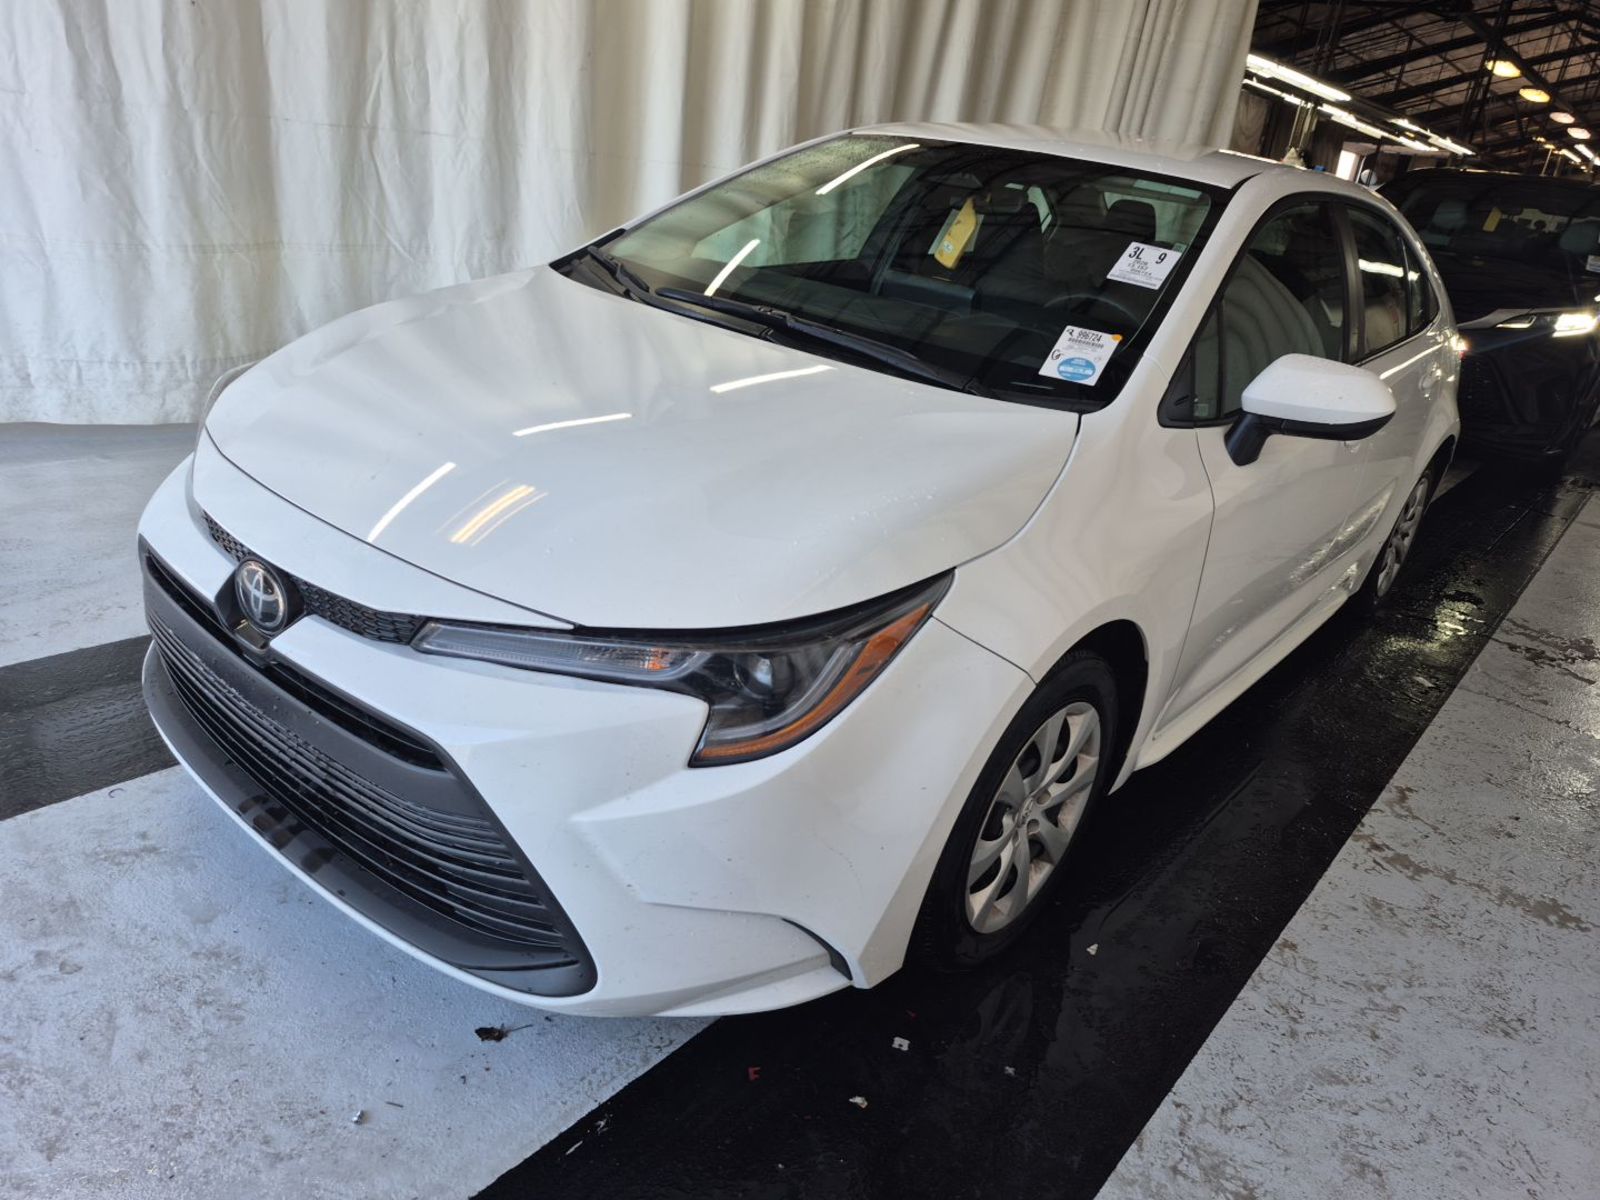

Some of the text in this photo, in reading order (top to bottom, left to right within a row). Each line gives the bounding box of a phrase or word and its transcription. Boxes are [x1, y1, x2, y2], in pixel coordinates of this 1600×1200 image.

[1128, 246, 1145, 260] 3L
[1155, 252, 1167, 265] 9
[1076, 330, 1103, 343] 996724
